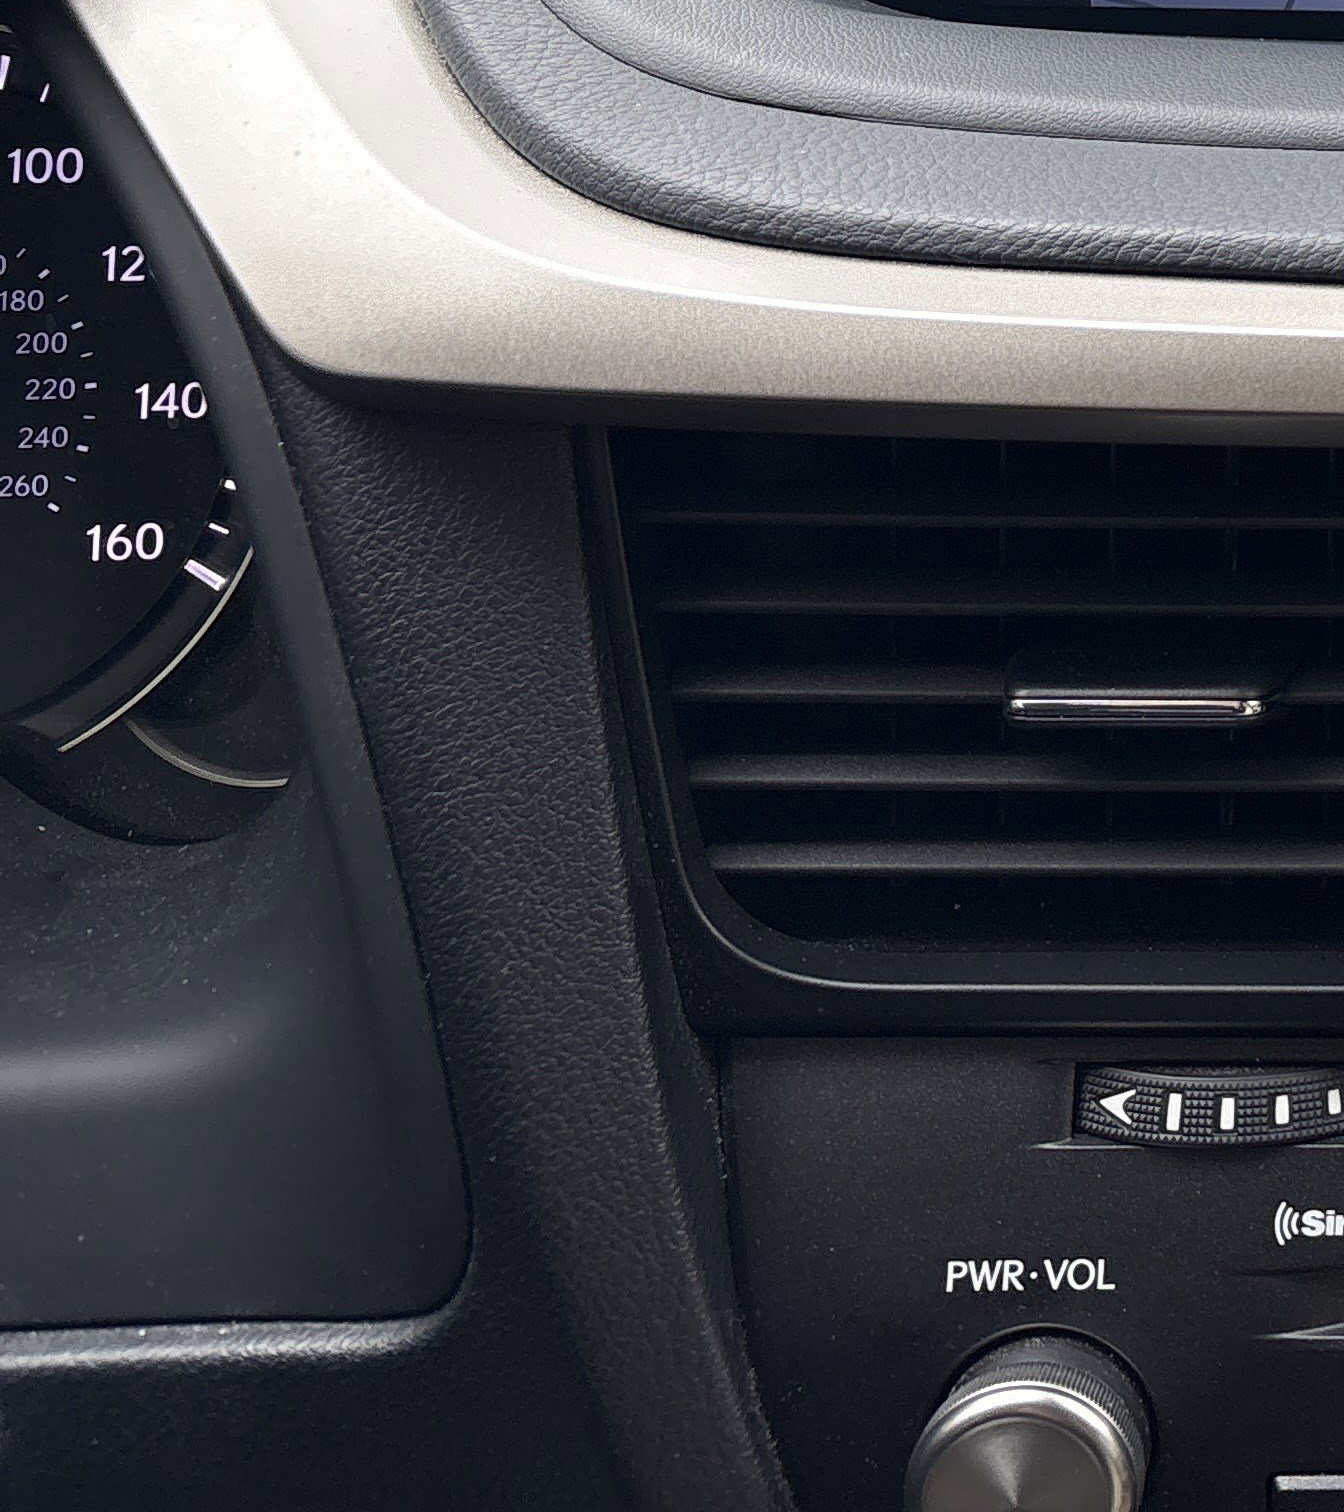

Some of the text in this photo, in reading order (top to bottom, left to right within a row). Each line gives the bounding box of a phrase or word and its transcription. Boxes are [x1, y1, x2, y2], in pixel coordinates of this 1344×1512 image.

[6, 146, 85, 185] 100
[101, 244, 148, 283] 12
[0, 288, 46, 313] 180
[14, 331, 69, 356] 200
[24, 376, 77, 402] 220
[134, 380, 209, 421] 140
[16, 425, 70, 450] 240
[0, 474, 50, 498] 260
[85, 521, 165, 563] 160
